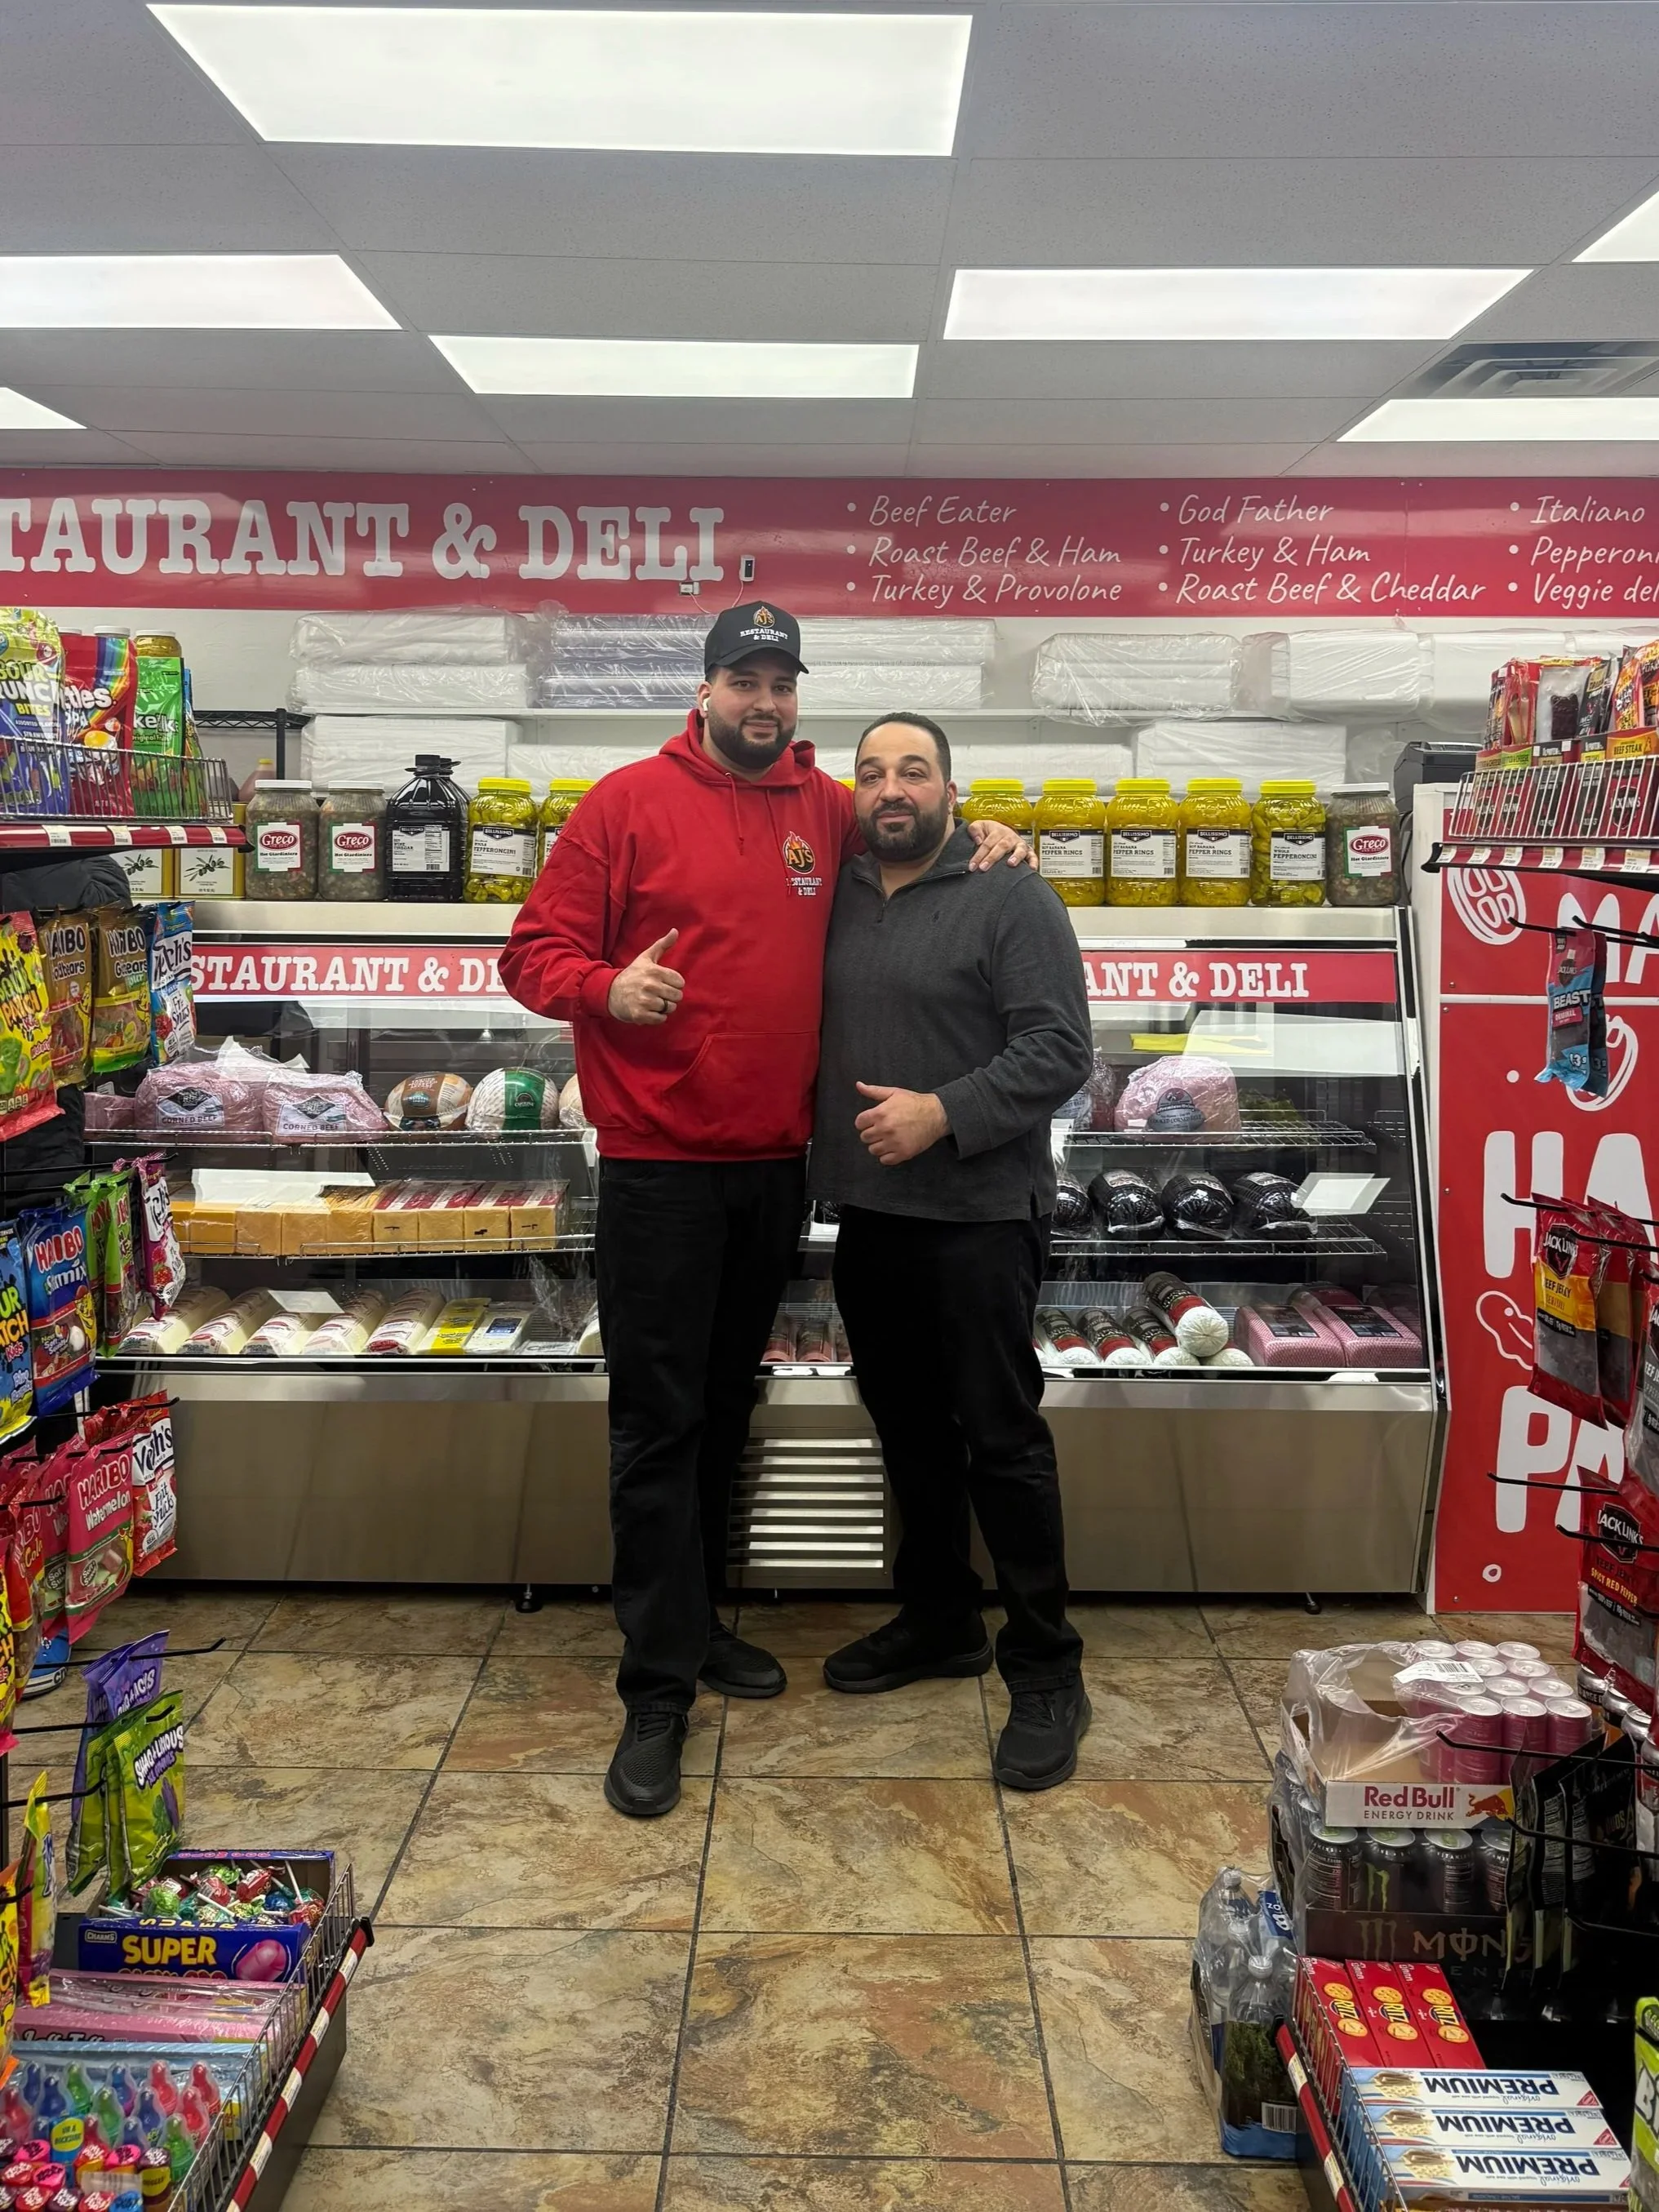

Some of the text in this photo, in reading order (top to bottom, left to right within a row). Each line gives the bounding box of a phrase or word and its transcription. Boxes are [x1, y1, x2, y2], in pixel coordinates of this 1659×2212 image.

[869, 495, 1017, 527] Beef Eater
[1178, 495, 1334, 525] God Father
[1530, 495, 1645, 523] Italiano
[432, 502, 498, 580] &
[519, 504, 725, 581] DELI
[869, 535, 1121, 567] Roast Beef & Ham
[1180, 534, 1371, 571] Turkey & Ham
[872, 574, 1122, 609] Turkey & Provolone
[1176, 571, 1487, 605] Roast Beef & Cheddar
[1534, 573, 1613, 610] Veggie
[739, 628, 788, 640] RESTAURANT
[761, 634, 779, 642] DELI
[0, 679, 60, 704] UNC
[16, 703, 51, 717] BITES
[262, 834, 295, 846] Greco
[336, 835, 370, 846] Greco
[1353, 839, 1386, 851] Greco
[788, 849, 814, 868] AJ'S
[417, 956, 449, 992] &
[1169, 961, 1200, 998] &
[1209, 962, 1310, 998] DELI
[1554, 989, 1590, 1009] BEAST
[1543, 1232, 1562, 1253] JACK
[78, 1454, 131, 1510] HARIBO
[86, 1490, 131, 1531] Watermelon
[1597, 1510, 1621, 1537] JACK
[1606, 1577, 1620, 1592] RED
[1364, 1785, 1455, 1809] Red Bull
[1364, 1810, 1455, 1821] ENERGY DRINK
[86, 1932, 115, 1941] CHARMS
[122, 1934, 217, 1965] SUPER
[1333, 1998, 1360, 2021] RITZ
[1382, 2002, 1409, 2023] RITZ
[1433, 2005, 1460, 2026] RITZ
[1424, 2077, 1559, 2095] PREMIUM
[1502, 2089, 1540, 2104] original
[1435, 2115, 1575, 2134] PREMIUM
[1517, 2128, 1555, 2143] original
[1455, 2156, 1599, 2175] PREMIUM
[1540, 2170, 1580, 2186] original
